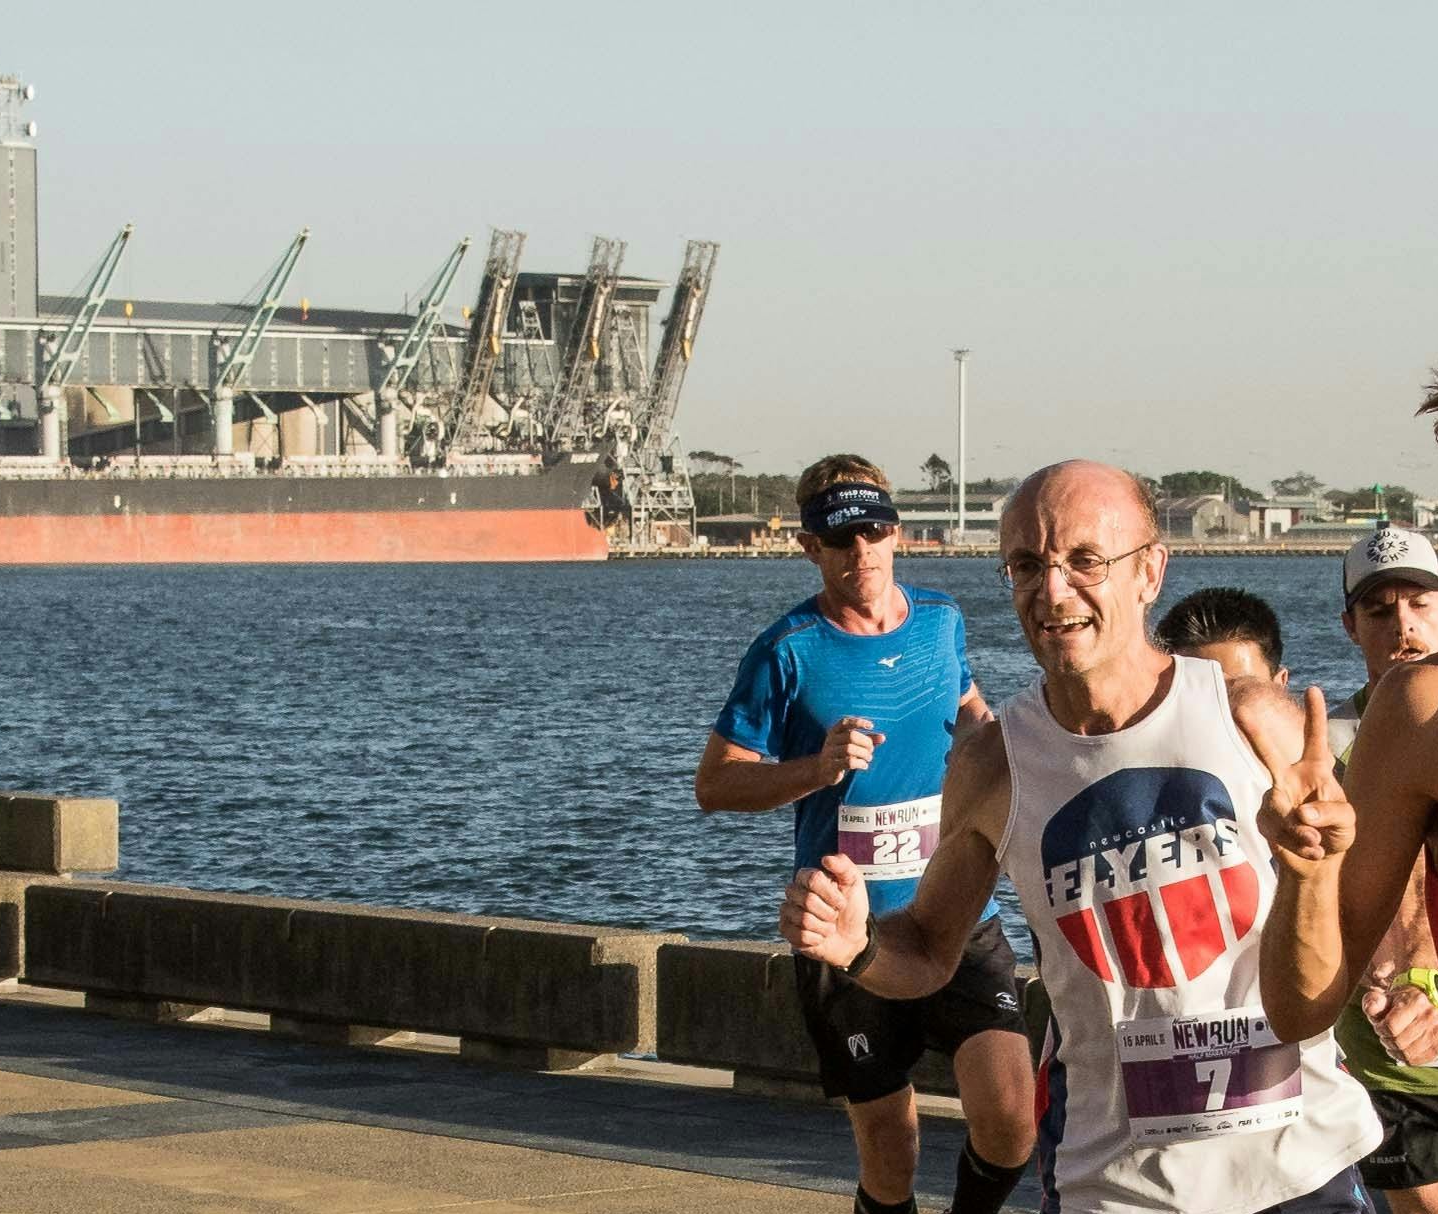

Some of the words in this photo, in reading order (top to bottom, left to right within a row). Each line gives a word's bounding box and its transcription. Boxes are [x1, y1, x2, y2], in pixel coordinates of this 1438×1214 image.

[873, 829, 921, 864] 22
[1089, 815, 1186, 850] newcastle
[1134, 1033, 1159, 1047] APRIL
[1195, 1058, 1232, 1111] 7
